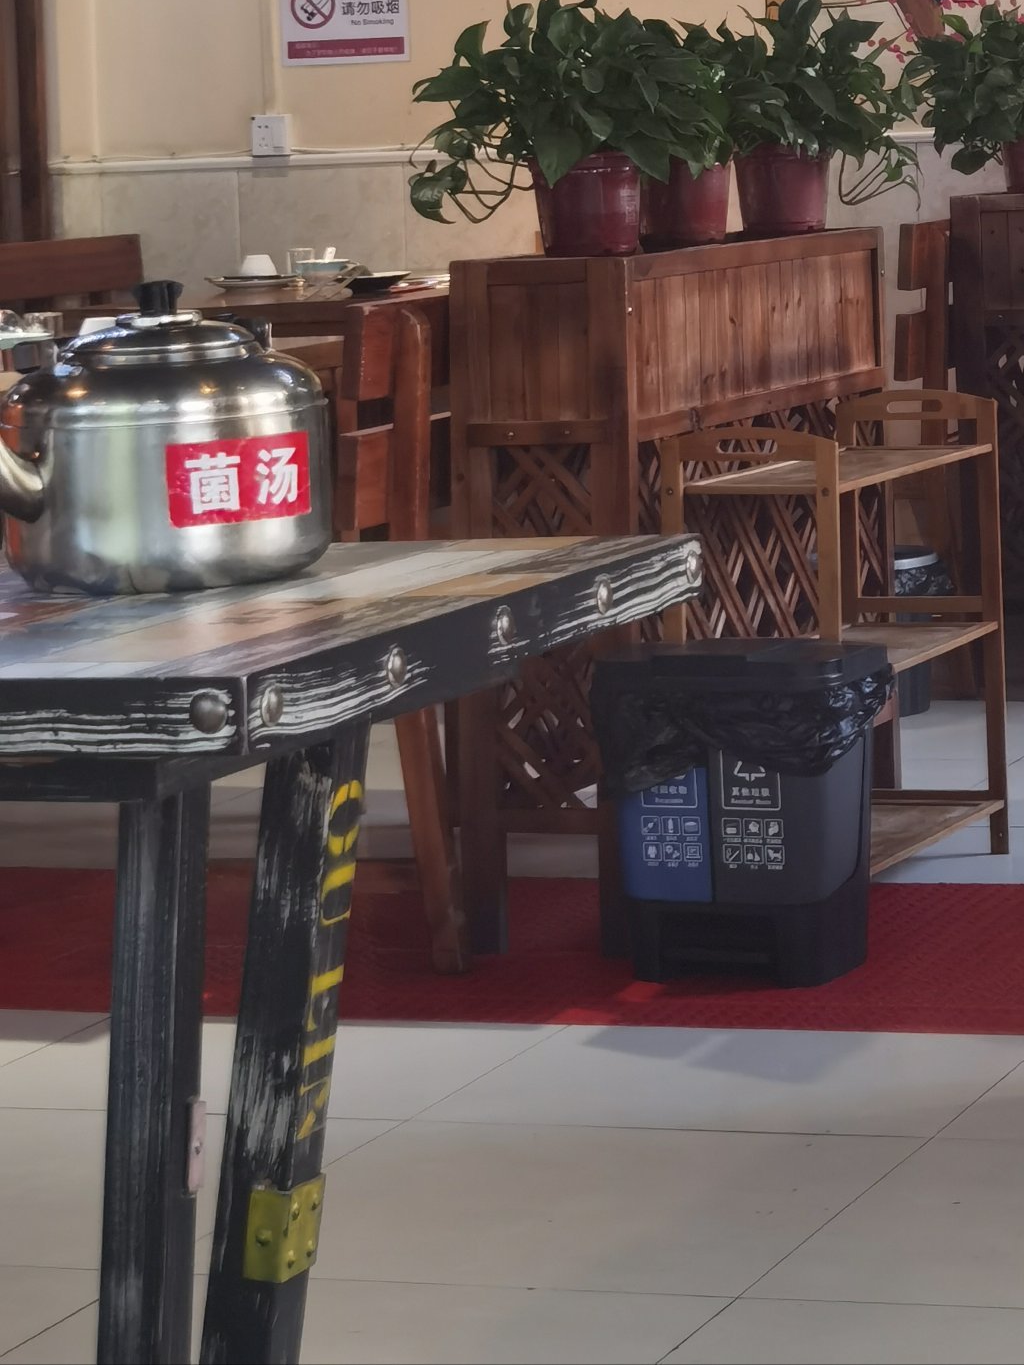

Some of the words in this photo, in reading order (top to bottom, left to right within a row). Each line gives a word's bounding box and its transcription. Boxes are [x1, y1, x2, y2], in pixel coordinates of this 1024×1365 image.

[341, 0, 400, 16] 请勿吸烟
[184, 446, 298, 515] 菌汤
